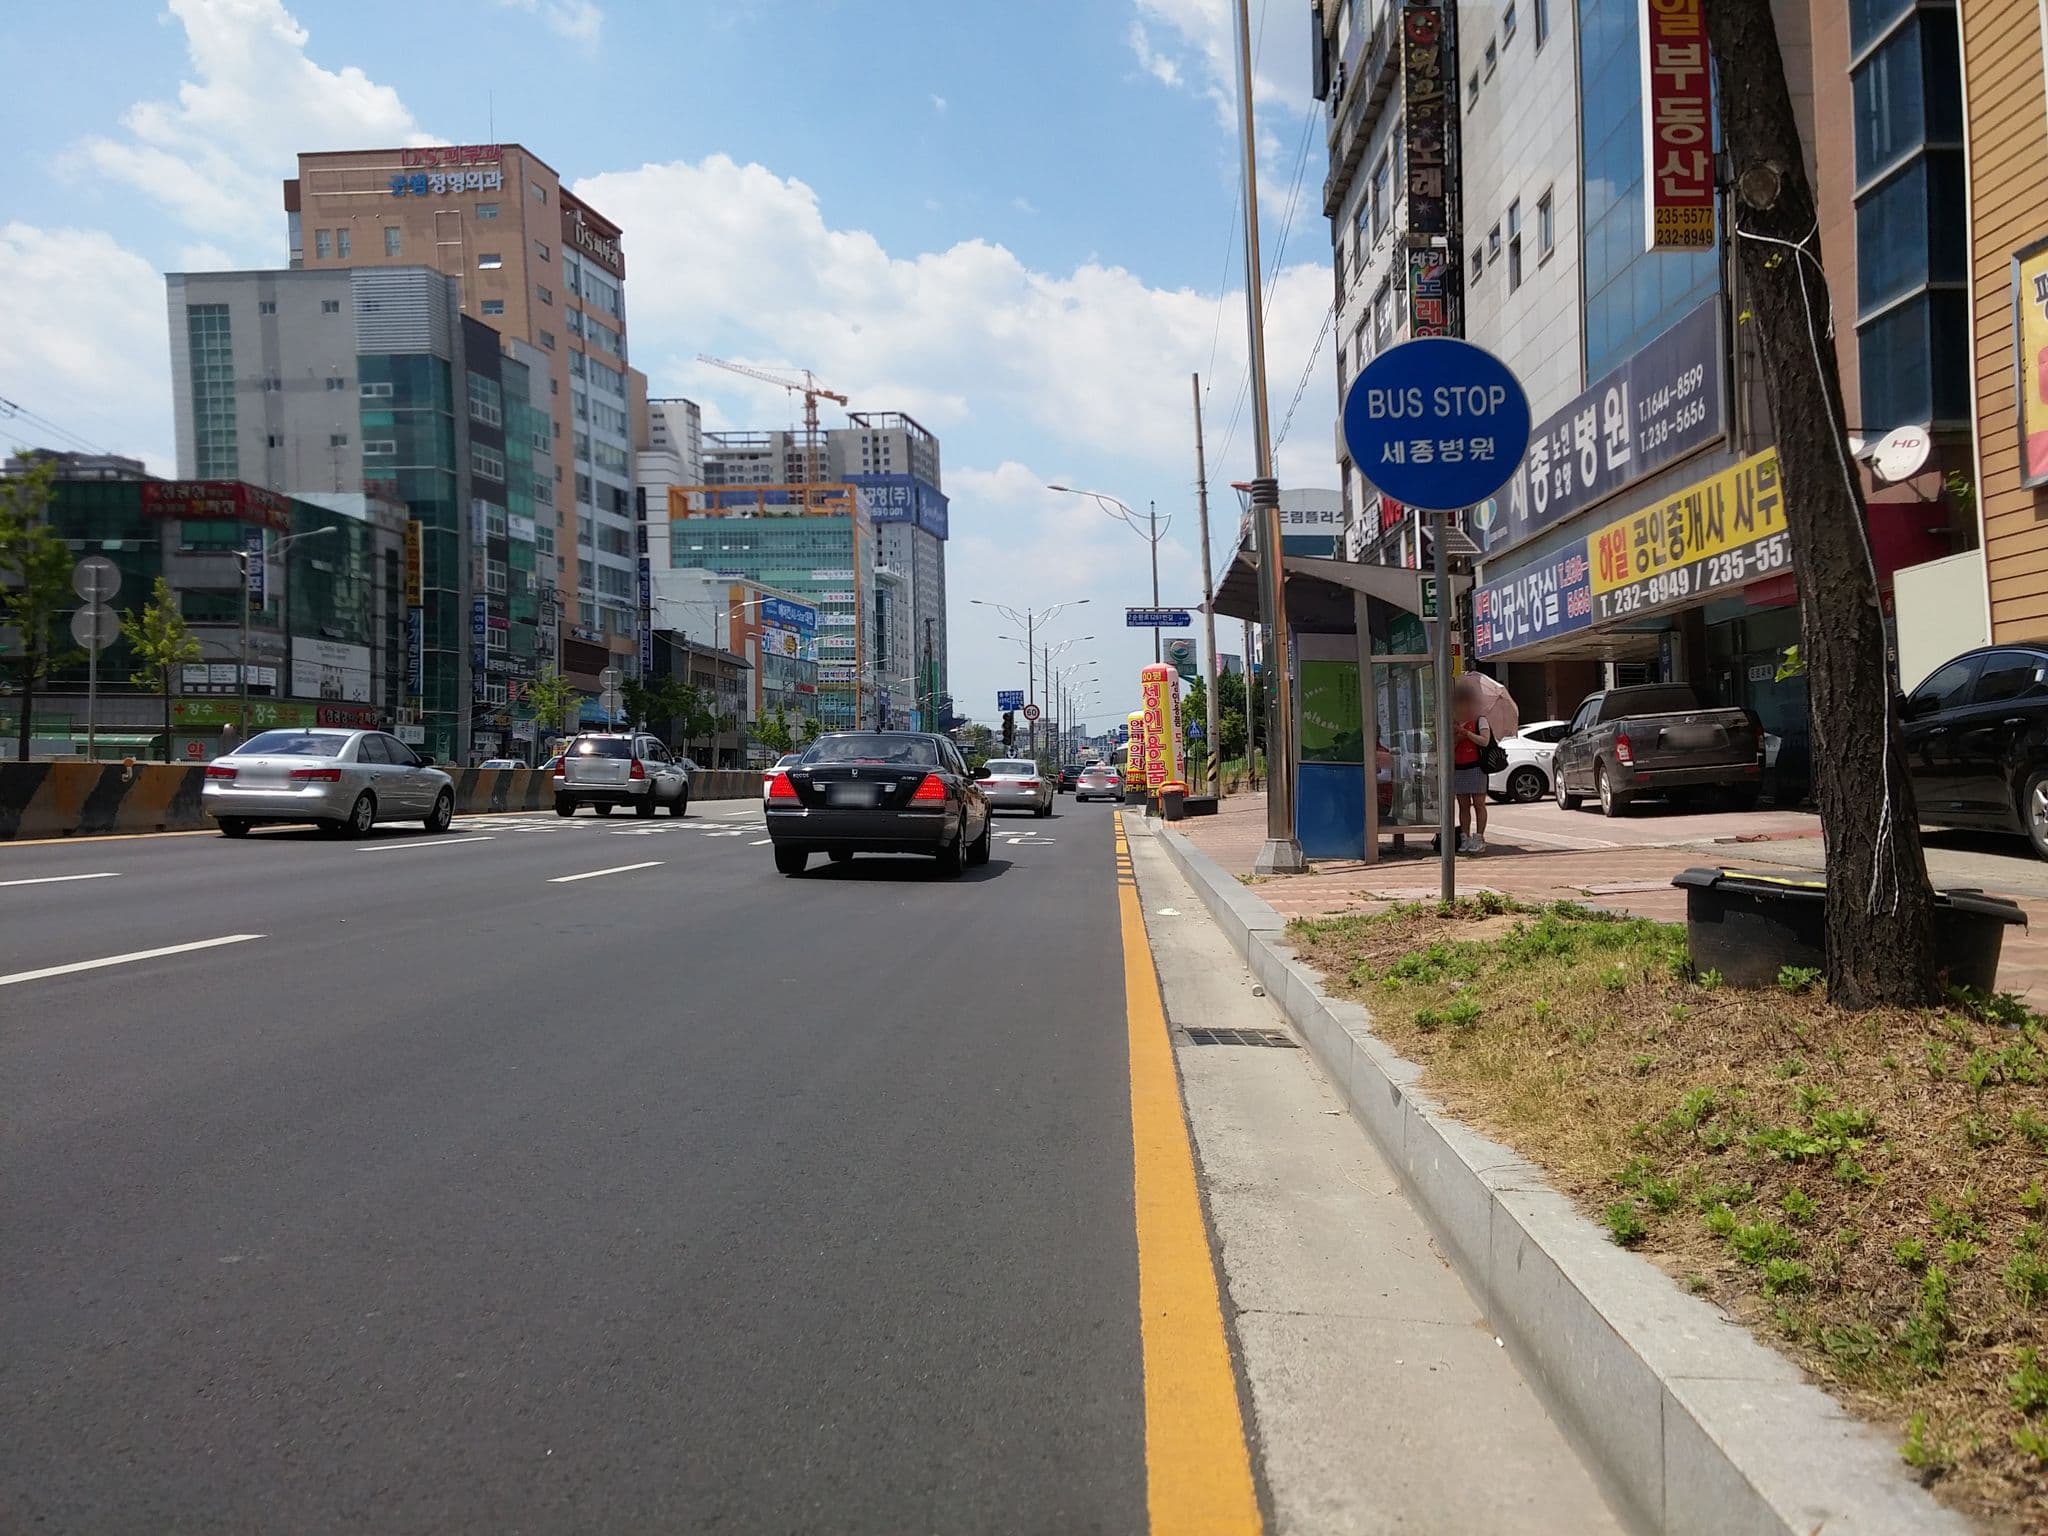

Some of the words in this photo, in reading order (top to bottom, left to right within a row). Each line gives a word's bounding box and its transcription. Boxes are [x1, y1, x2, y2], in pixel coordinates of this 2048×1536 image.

[1656, 208, 1713, 224] 235-5577
[1656, 229, 1714, 245] 232-8949
[1368, 387, 1424, 419] BUS
[1433, 385, 1506, 417] STOP
[1639, 363, 1704, 423] T.1644-8599
[1552, 422, 1570, 461] 노인
[1574, 381, 1631, 488] 병원
[1640, 397, 1706, 453] T.238-5656
[1891, 439, 1921, 448] HD
[1380, 437, 1495, 464] 세종병원
[860, 486, 911, 507] 공영(주)
[1510, 435, 1550, 521] 세종
[1554, 461, 1572, 500] 요양
[1599, 527, 1629, 582] 하일
[1633, 482, 1725, 574] 공인중개사
[1734, 457, 1786, 533] 사무
[1491, 565, 1560, 643] 인공신장실
[1615, 567, 1690, 614] 232-8949
[1026, 708, 1037, 717] 60
